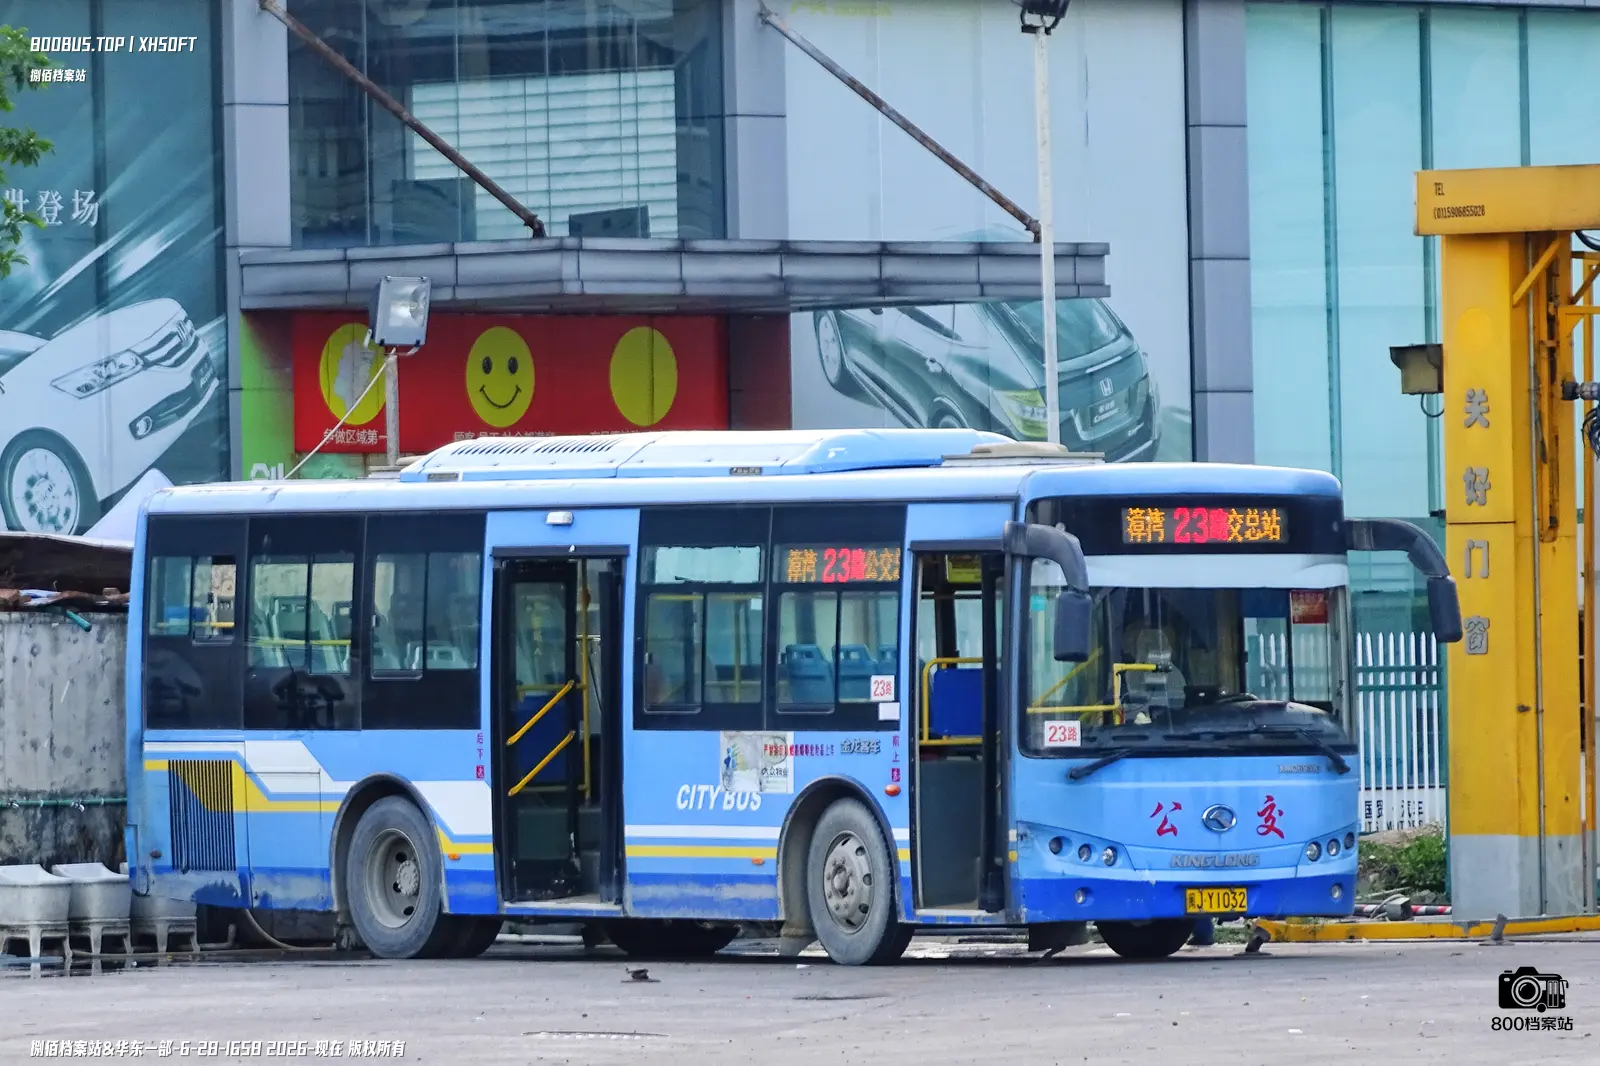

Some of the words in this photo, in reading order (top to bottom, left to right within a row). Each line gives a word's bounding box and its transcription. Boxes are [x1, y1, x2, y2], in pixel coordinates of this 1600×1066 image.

[1434, 182, 1445, 196] TEL
[1463, 388, 1491, 655] 关好门窗
[1048, 725, 1077, 743] 23路
[676, 784, 720, 810] CITY
[723, 791, 761, 811] BUS
[1150, 801, 1182, 837] 公
[1256, 795, 1285, 839] 交
